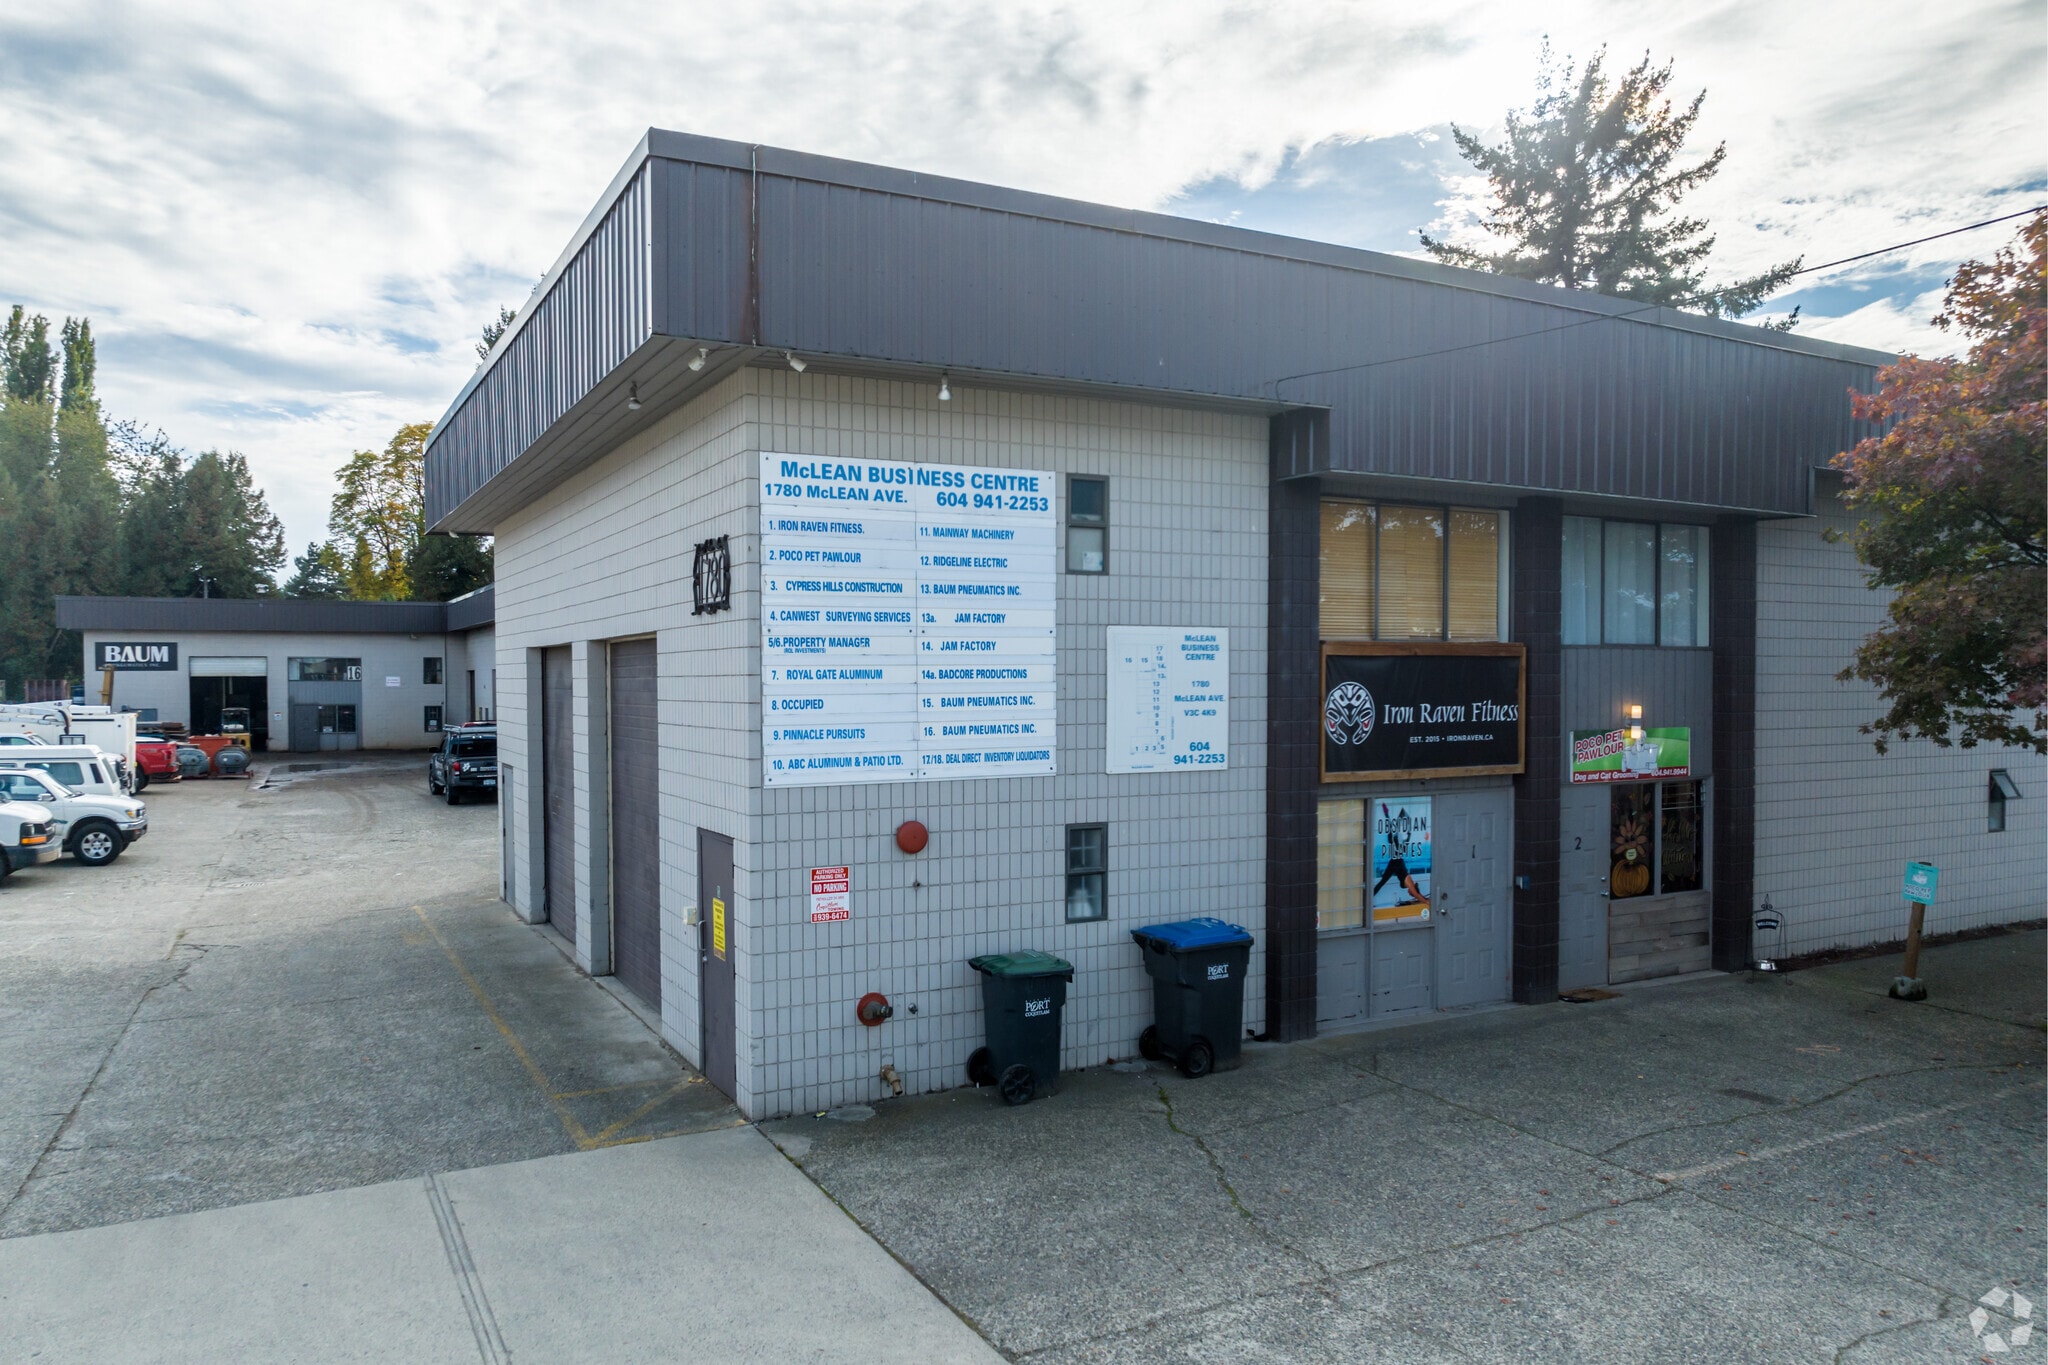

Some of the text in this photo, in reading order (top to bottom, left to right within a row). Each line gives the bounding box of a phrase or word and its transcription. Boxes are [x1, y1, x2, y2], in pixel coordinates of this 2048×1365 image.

[781, 461, 1039, 492] McLEAN BUSINESS CENTRE
[764, 484, 908, 503] 1780 McLEAN AVE.
[937, 492, 1049, 512] 604 941-2253
[769, 520, 864, 534] 1. IRON RAVEN FITNESS.
[920, 528, 1014, 540] 11. MAINWAY MACHINERY
[769, 550, 861, 563] 2. POCO PET PAWLOUR
[920, 556, 1007, 569] 12. RIDGELINE ELECTRIC
[770, 581, 903, 593] 3. CYPRESS HILLS CONSTRUCTION
[921, 584, 1021, 596] 13. BAUM PNEUMATICS INC.
[770, 611, 911, 623] 4. CANWEST SURVEYING SERVICES
[922, 613, 1006, 624] 13a. JAM FACTORY
[829, 637, 870, 648] MANAGER
[922, 641, 996, 651] 14. JAM FACTORY
[105, 646, 169, 662] BAUM
[348, 667, 361, 679] 16
[772, 669, 883, 680] 7. ROYAL GATE ALUMINUM
[922, 669, 1027, 680] 14a. BADCORE PRODUCTIONS
[772, 699, 824, 710] 8. OCCUPIED
[922, 696, 1035, 708] 15. BAUM PNEUMATICS INC.
[1383, 700, 1519, 724] Iron Raven Fitness
[773, 728, 865, 740] 9. PINNACLE PURSUITS
[924, 724, 1037, 736] 16. BAUM PNEUMATICS INC.
[1446, 734, 1494, 742] IRONRAVEN.CA
[1575, 729, 1624, 753] POCO PET
[1190, 742, 1210, 751] 604
[1577, 741, 1624, 764] PAWLOUR
[772, 755, 903, 770] 10. ABC ALUMINUM & PATIO LTD.
[946, 754, 960, 763] DEAL
[962, 753, 981, 763] DIRECT
[984, 752, 1015, 762] INVENTORY
[1016, 751, 1050, 761] LIQUIDATORS
[1174, 754, 1225, 764] 941-2253
[1574, 773, 1586, 782] Dog
[1378, 817, 1427, 834] OBSIDIAN
[1575, 837, 1582, 850] 2
[1381, 842, 1422, 859] PILATES
[814, 883, 846, 892] NO PARKING
[818, 912, 847, 921] 939-6474
[1208, 965, 1228, 975] PORT
[1025, 1000, 1050, 1011] PORT
